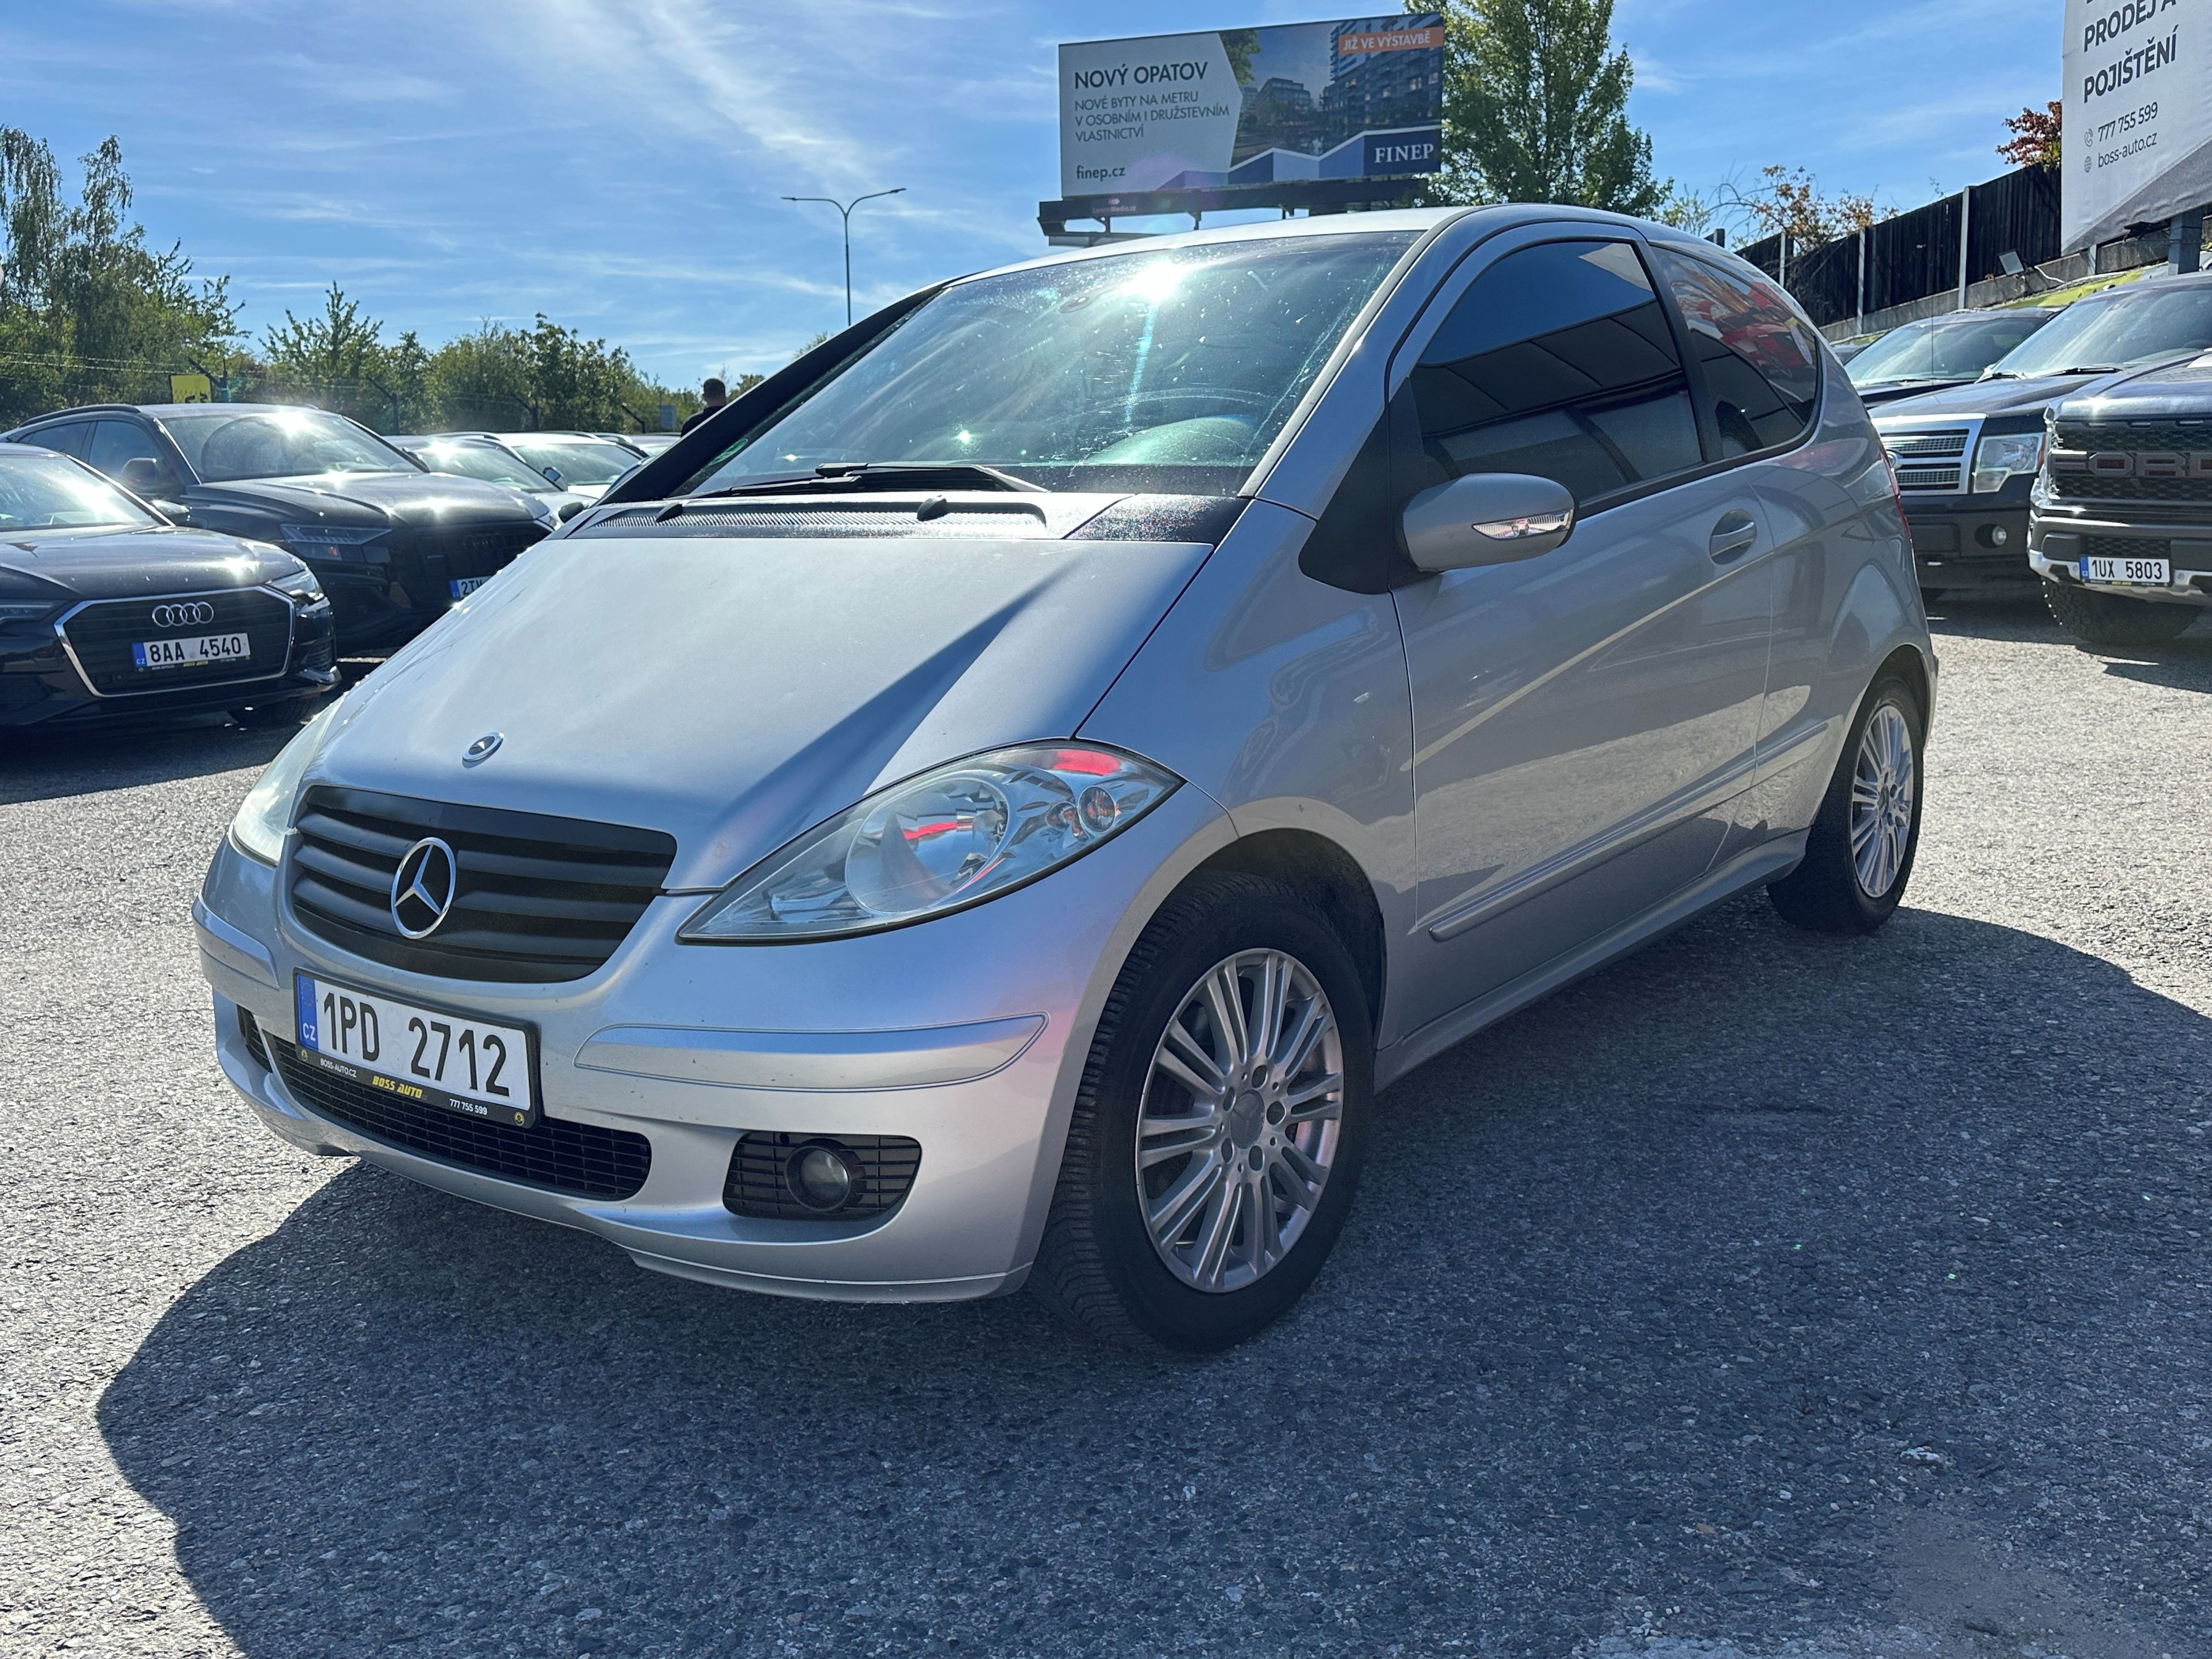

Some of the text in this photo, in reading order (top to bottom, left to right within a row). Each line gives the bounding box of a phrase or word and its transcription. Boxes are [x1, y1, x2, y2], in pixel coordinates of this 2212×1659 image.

[2084, 0, 2156, 52] PRODEJ
[1343, 30, 1431, 51] JIŽ VE VÝSTAVBĚ
[1075, 61, 1209, 89] NOVÝ OPATOV
[2084, 24, 2179, 103] POJIŠTĚNÍ
[1075, 91, 1199, 111] NOVÉ BYTY NA METRU
[1075, 116, 1084, 127] V
[1086, 110, 1142, 126] OSOBNÍM
[1151, 103, 1229, 121] DRUŽSTEVNÍM
[2097, 101, 2158, 142] 777 755 599
[1075, 124, 1144, 143] VLASTNICTVÍ
[1374, 143, 1435, 163] FINEP
[2097, 133, 2158, 168] boss-auto.cz
[1076, 165, 1126, 182] finep.cz
[2092, 560, 2115, 578] 1UX
[2125, 561, 2163, 579] 5803
[149, 642, 185, 663] 8AA
[200, 636, 241, 658] 4540
[302, 991, 510, 1097] CZ 1PD 2712
[320, 1058, 488, 1115] BOSS-AUTO.CZ BOSS AUTO 777 755 599
